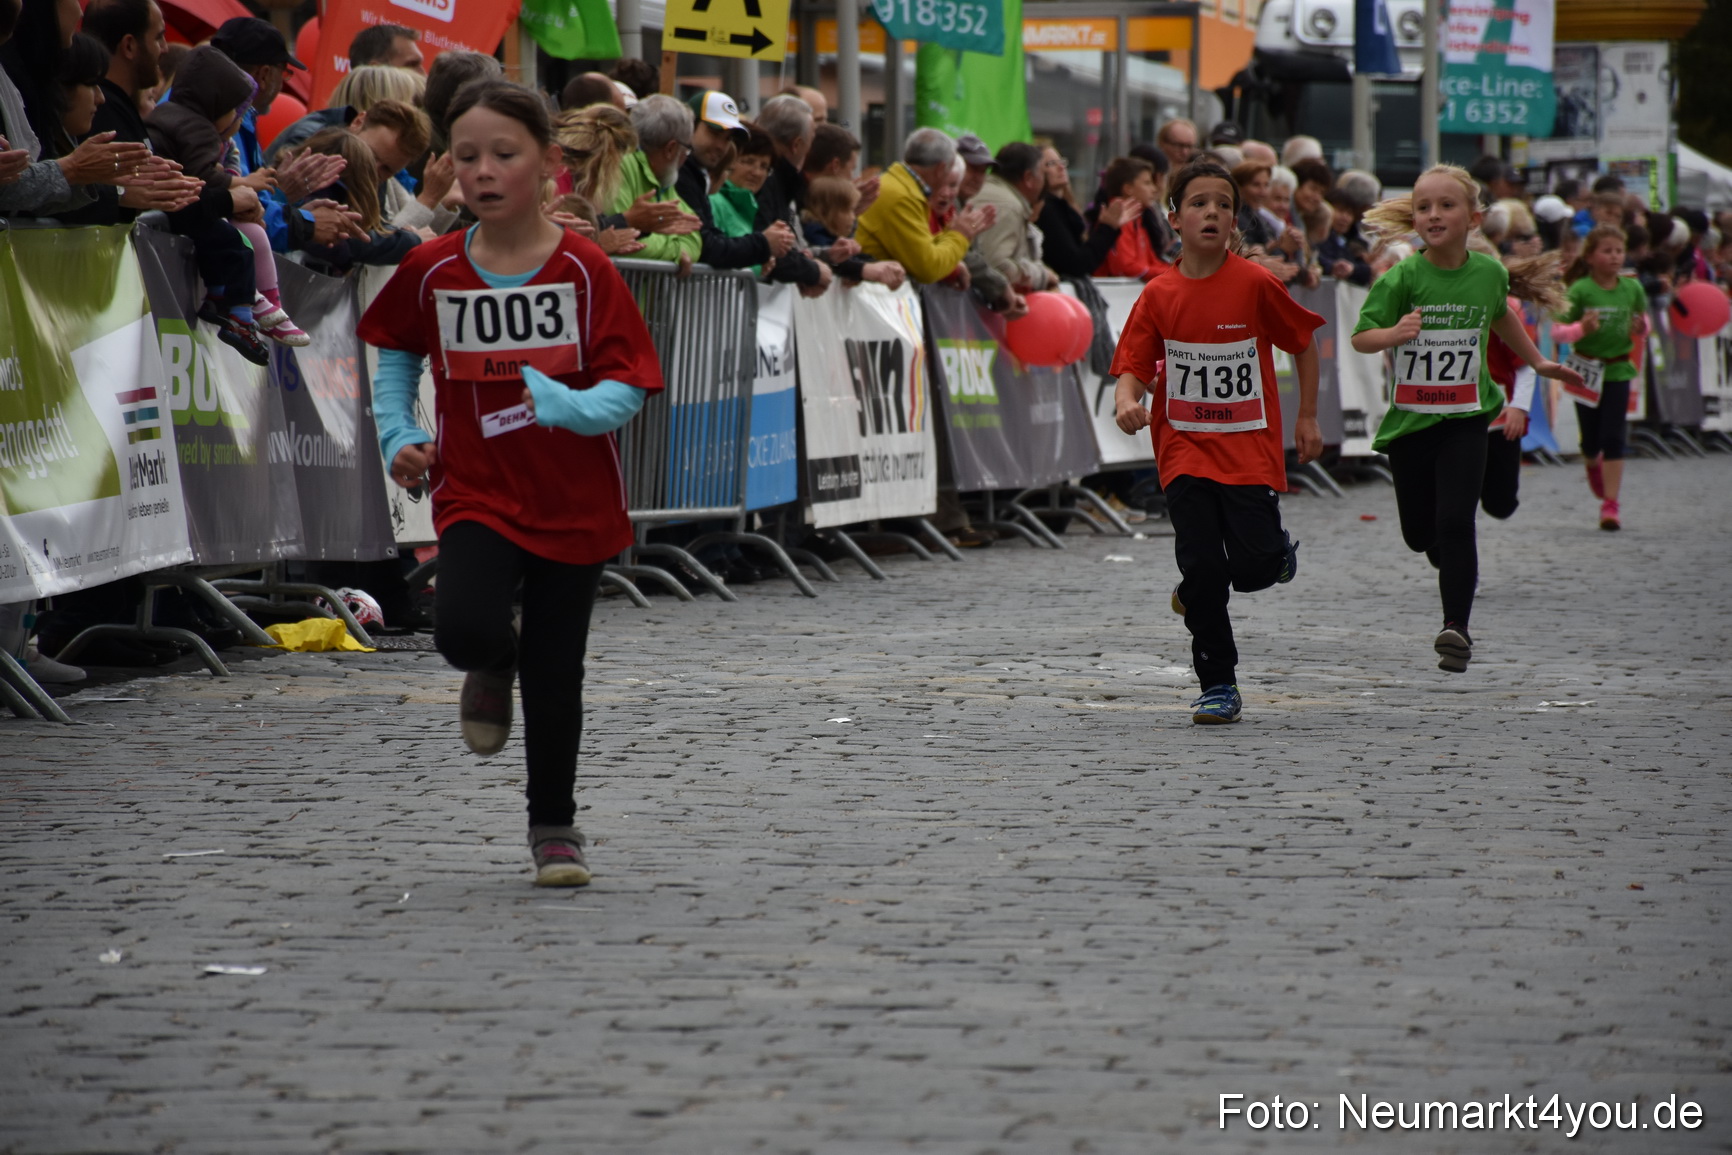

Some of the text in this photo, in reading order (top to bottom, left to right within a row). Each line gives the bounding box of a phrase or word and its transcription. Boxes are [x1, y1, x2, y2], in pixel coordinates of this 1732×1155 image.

[361, 9, 377, 25] Wir
[1465, 99, 1528, 125] 6352
[447, 291, 563, 344] 7003
[1424, 339, 1467, 347] Neumarkt
[1168, 348, 1245, 362] PARTL Neumarkt
[1404, 350, 1473, 381] 7127
[938, 347, 996, 396] BOCK
[1175, 363, 1252, 398] 7138
[1416, 389, 1456, 403] Sophie
[499, 411, 527, 427] DEHN
[1194, 406, 1232, 420] Sarah
[199, 435, 211, 472] by
